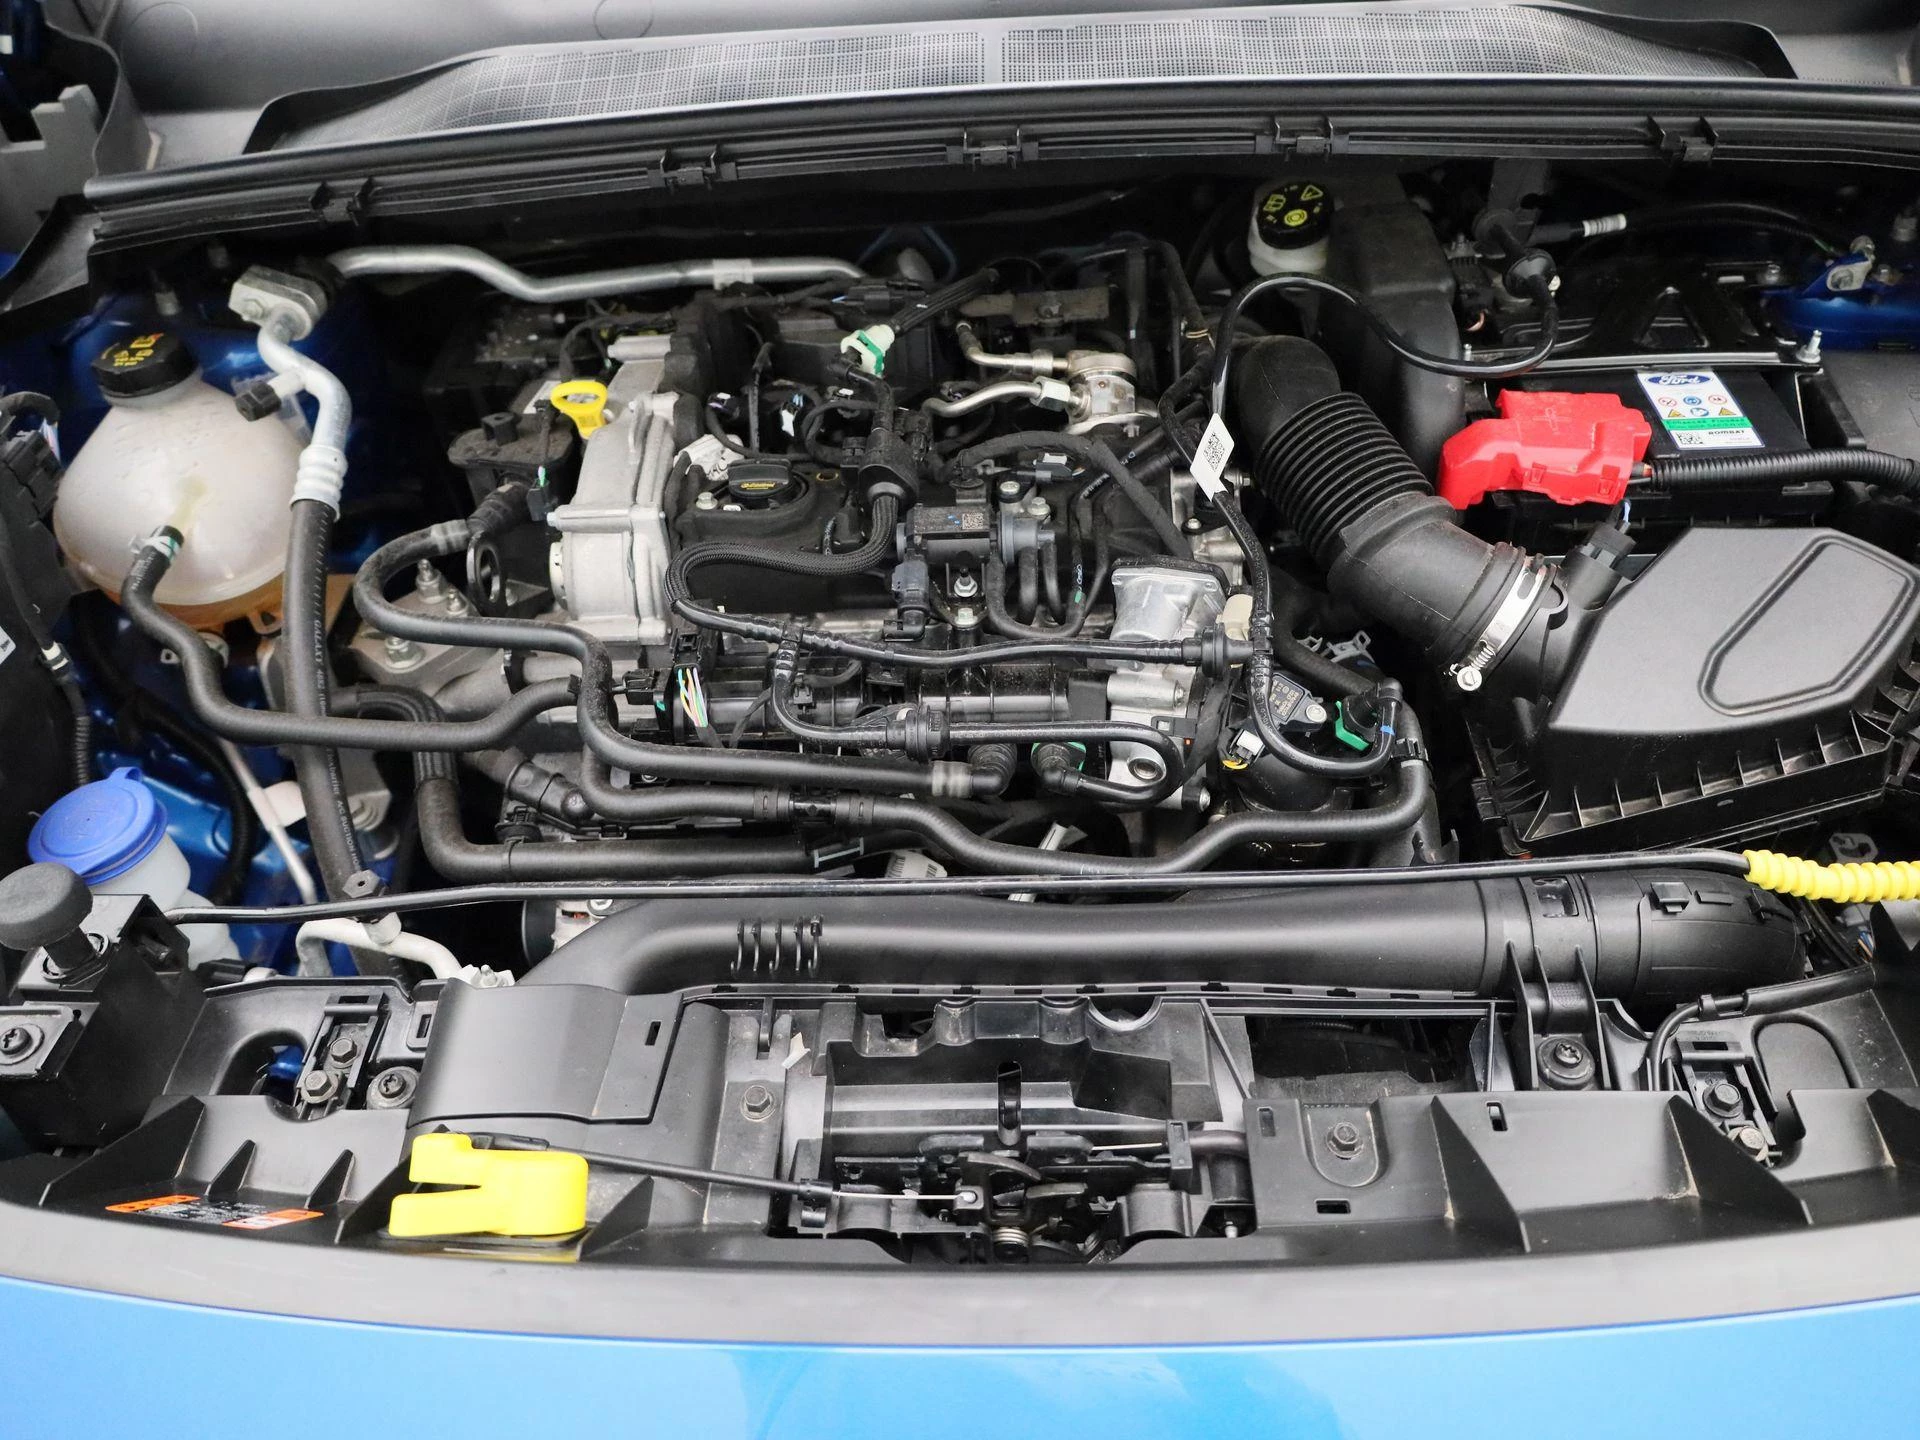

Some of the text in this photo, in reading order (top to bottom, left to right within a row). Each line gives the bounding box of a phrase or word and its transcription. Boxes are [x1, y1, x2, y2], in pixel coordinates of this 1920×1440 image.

[1658, 374, 1701, 385] Ford
[314, 619, 323, 664] GALAXY
[341, 815, 357, 852] SUCTION
